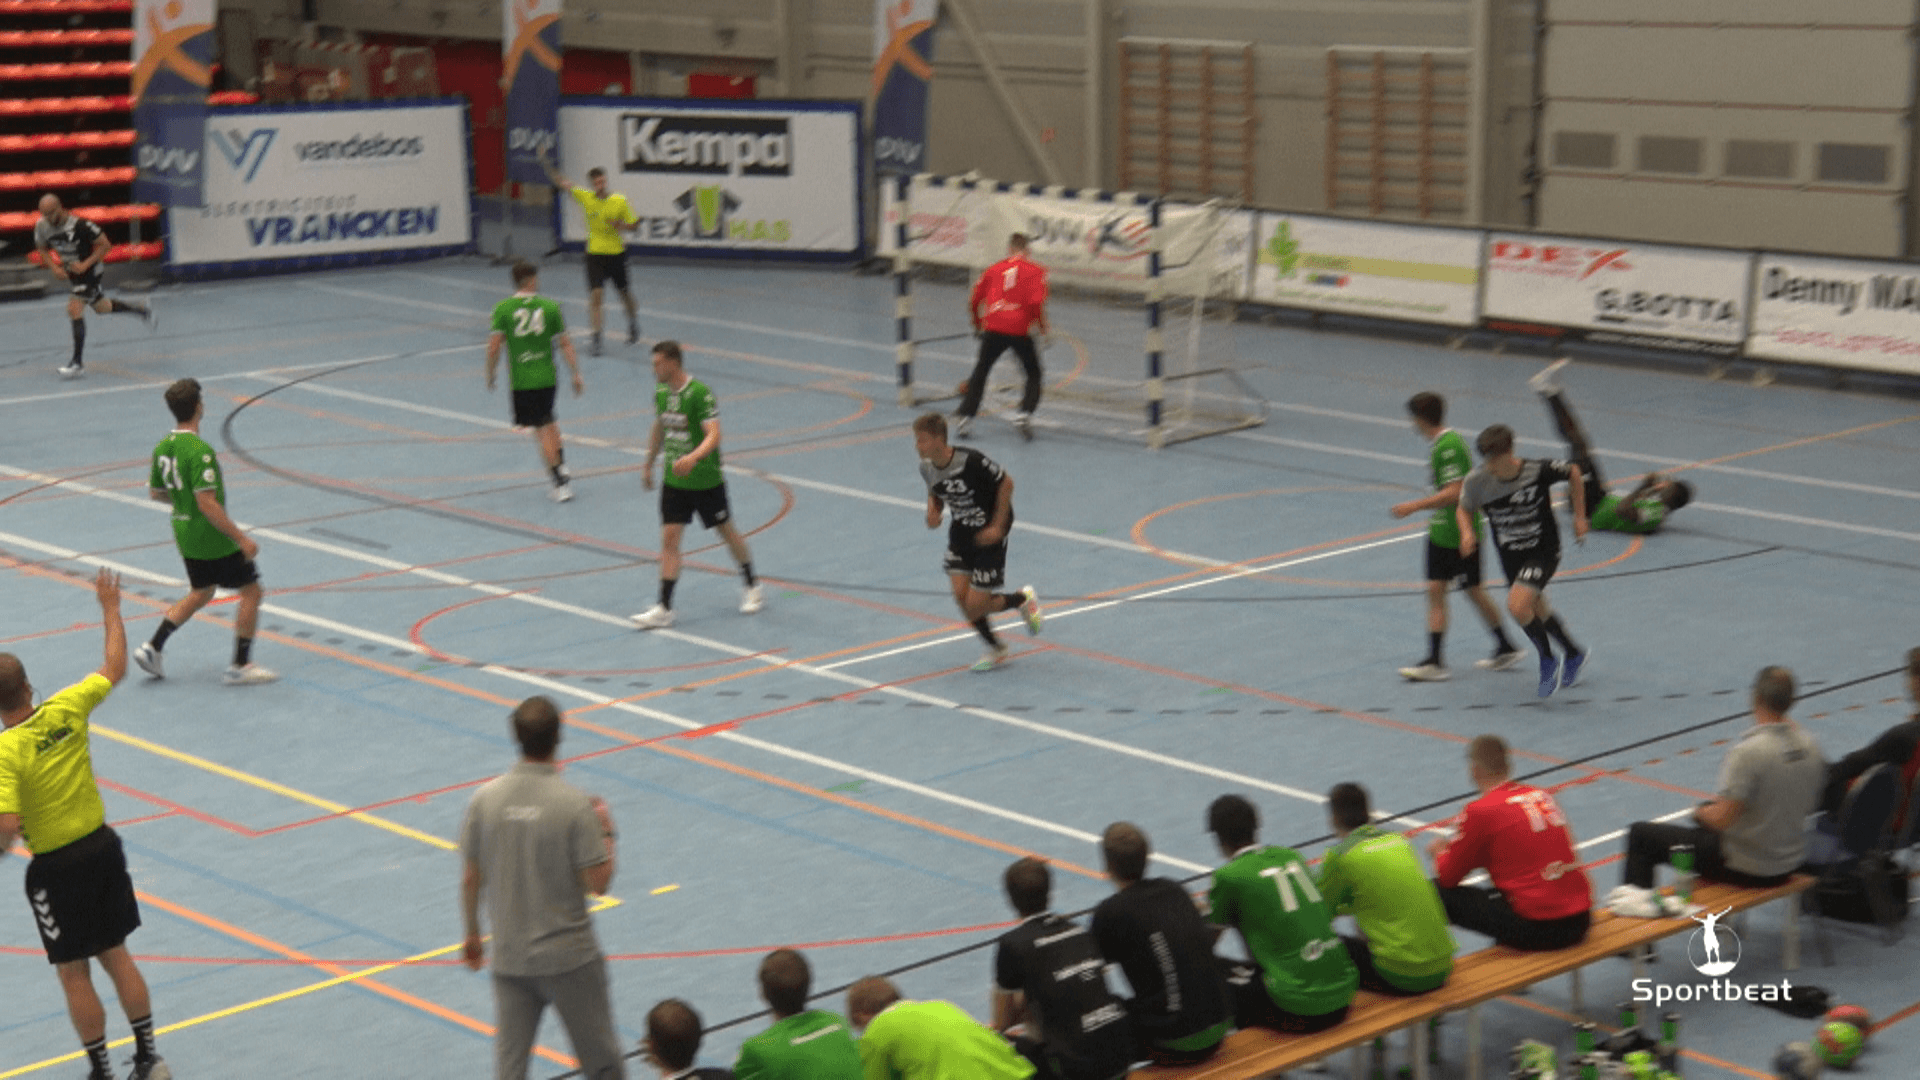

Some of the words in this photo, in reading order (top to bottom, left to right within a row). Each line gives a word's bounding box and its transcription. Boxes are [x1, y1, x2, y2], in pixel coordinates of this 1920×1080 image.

[622, 117, 790, 174] Kempa
[246, 193, 438, 247] VRANCKEN
[1762, 266, 1863, 316] Denny
[513, 307, 547, 337] 24
[942, 478, 968, 494] 23
